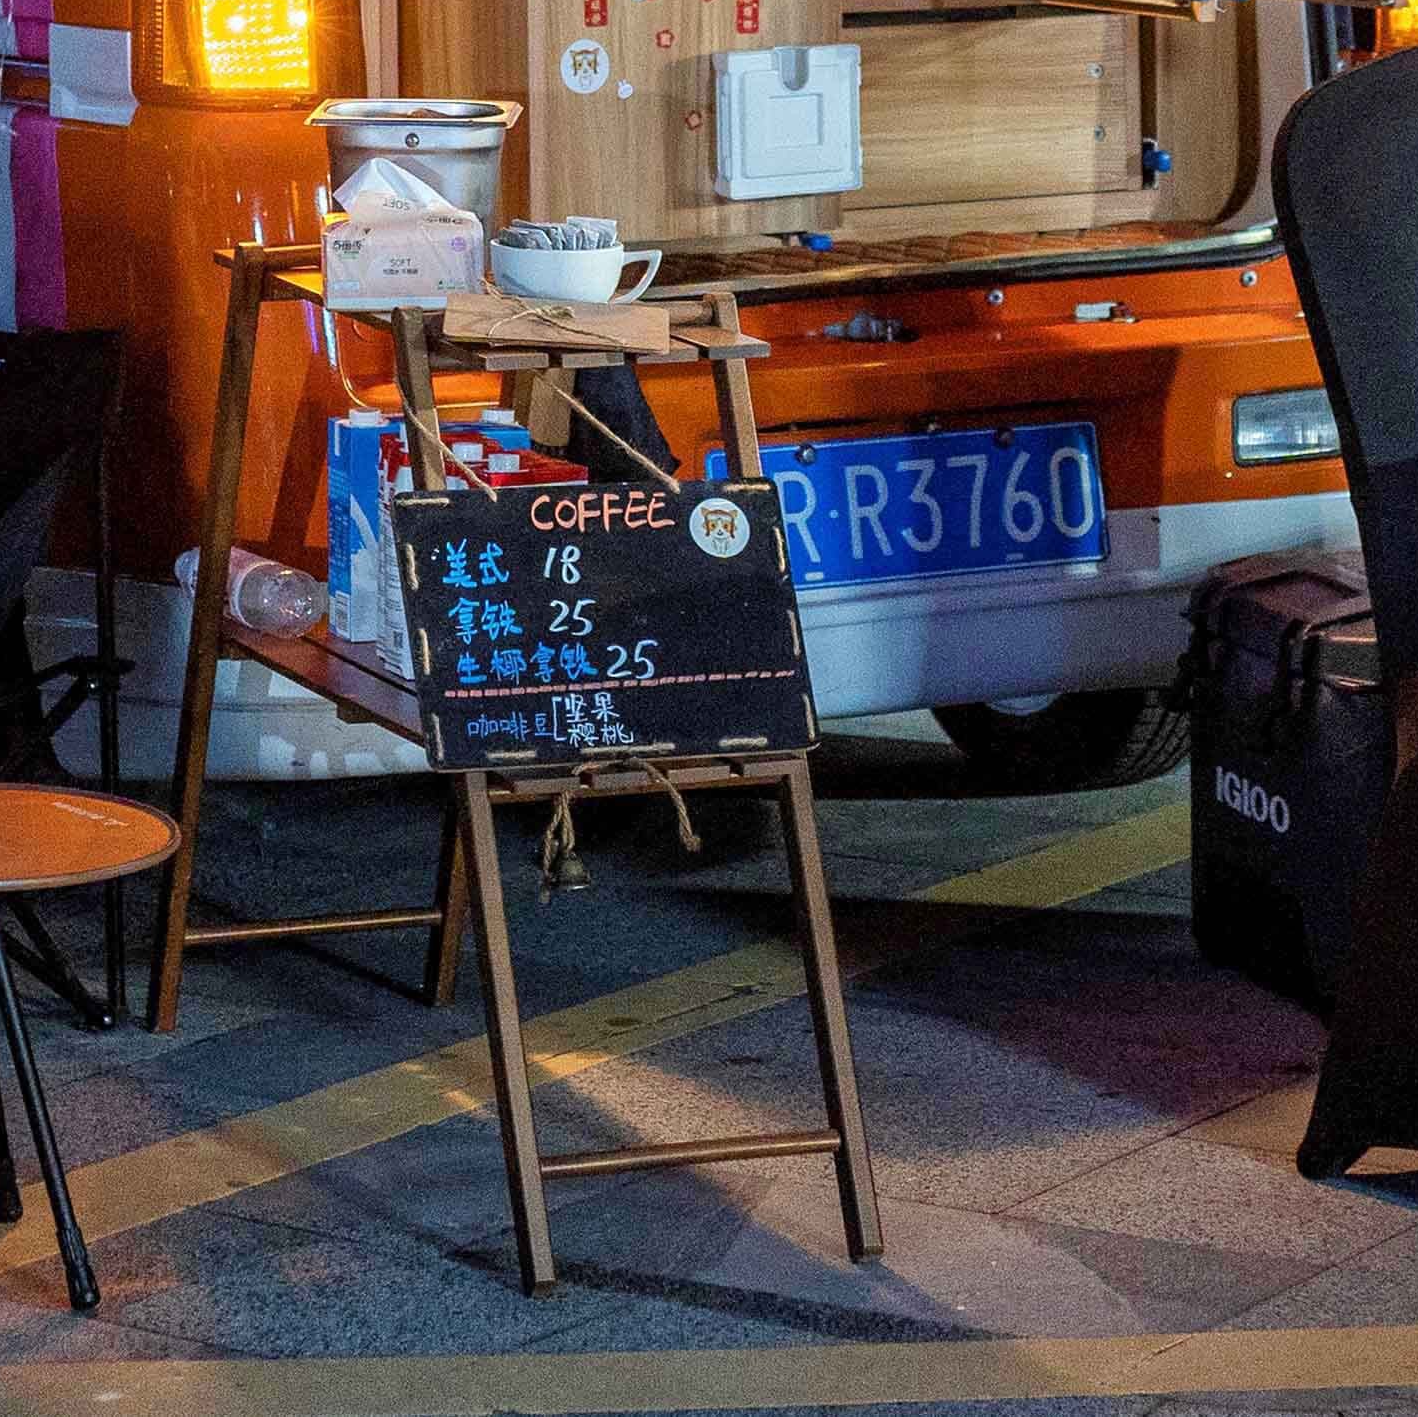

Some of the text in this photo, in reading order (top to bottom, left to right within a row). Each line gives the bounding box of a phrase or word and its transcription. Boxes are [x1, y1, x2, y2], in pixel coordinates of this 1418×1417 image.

[531, 490, 676, 533] COFFEE
[442, 538, 581, 588] 美式 18
[448, 596, 597, 645] 拿铁 25
[456, 639, 659, 685] 生椰拿铁 25
[466, 709, 554, 742] 咖啡豆
[564, 691, 620, 724] 坚果
[567, 723, 634, 749] 樱桃
